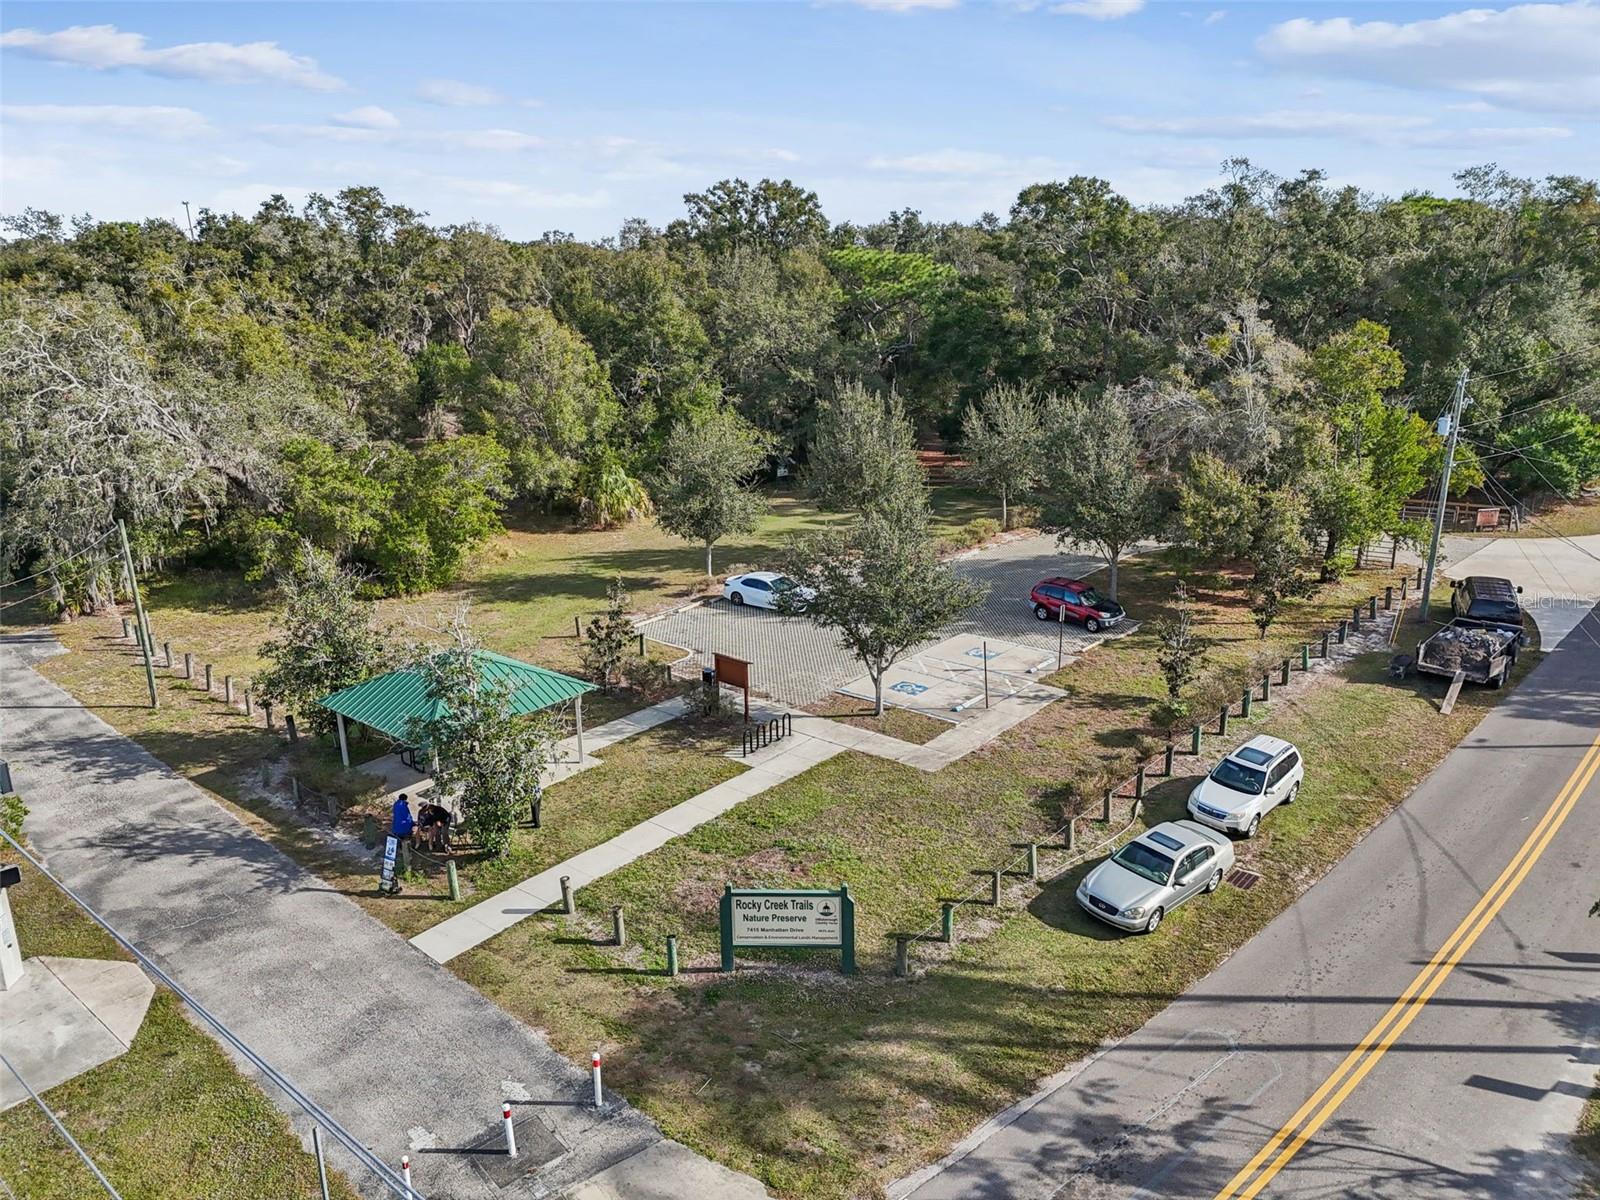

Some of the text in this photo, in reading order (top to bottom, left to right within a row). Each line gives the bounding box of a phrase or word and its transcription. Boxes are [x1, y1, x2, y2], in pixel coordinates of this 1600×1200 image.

[736, 899, 814, 912] Rocky Creek Trails
